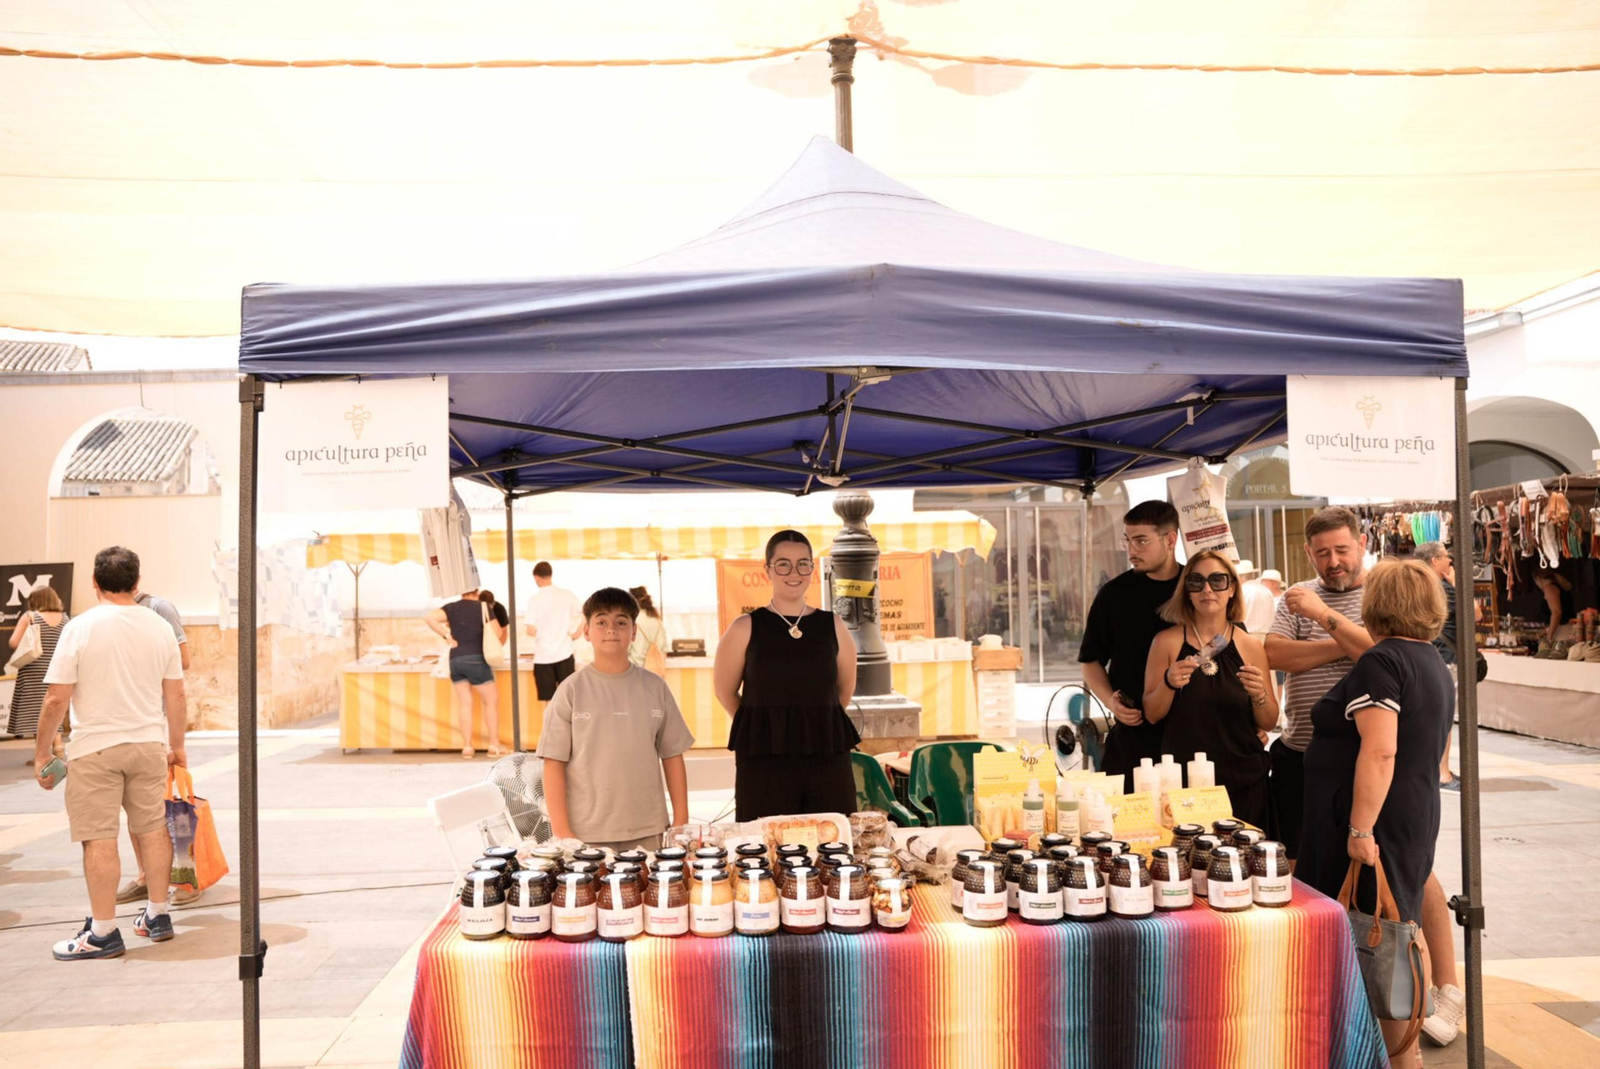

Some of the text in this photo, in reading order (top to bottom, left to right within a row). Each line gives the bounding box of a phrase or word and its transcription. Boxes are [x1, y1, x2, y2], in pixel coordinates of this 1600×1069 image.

[1305, 433, 1435, 455] apicultura peña
[285, 442, 427, 465] apicultura peña
[1245, 484, 1278, 494] PORTAL
[879, 565, 901, 580] RIA
[6, 574, 53, 607] M
[880, 598, 904, 607] COCHO
[880, 611, 902, 619] EMAS
